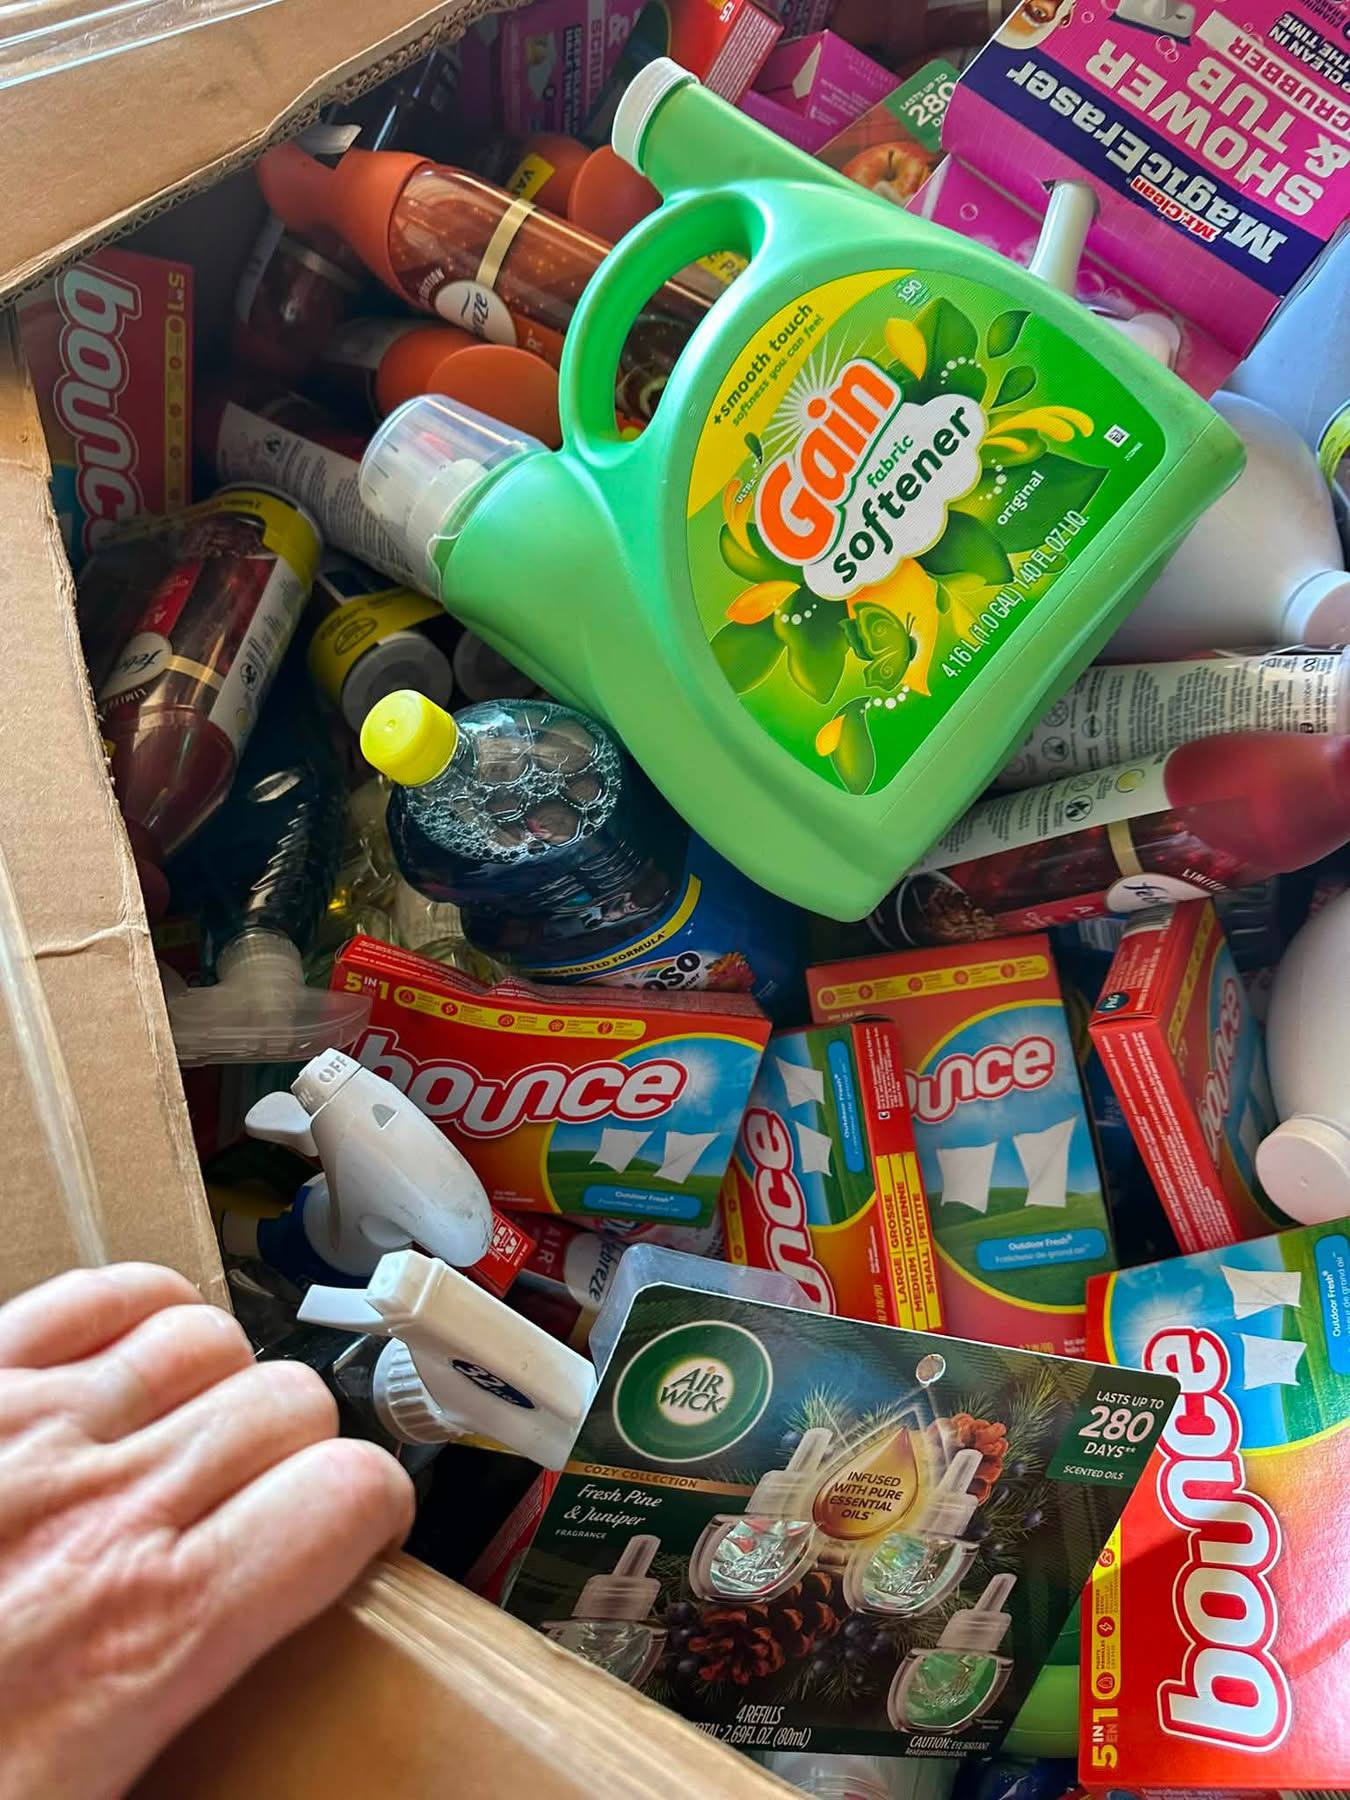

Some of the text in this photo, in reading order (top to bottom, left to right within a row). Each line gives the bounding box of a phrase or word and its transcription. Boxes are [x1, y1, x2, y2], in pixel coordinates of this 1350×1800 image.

[1279, 13, 1319, 49] TIME
[1269, 26, 1344, 84] CLEAN IN
[901, 73, 948, 110] LASTS UP TO
[907, 81, 956, 127] 280
[1187, 57, 1296, 153] TUB
[1228, 36, 1350, 131] CRUBBER
[1085, 39, 1324, 217] SHOWER
[1304, 133, 1350, 179] &
[768, 305, 813, 351] touch
[733, 314, 824, 426] softness you can feel
[54, 267, 142, 548] bounc
[758, 362, 896, 560] Gain
[866, 435, 914, 490] fabric
[735, 476, 757, 503] ULTRA
[833, 407, 971, 583] softener
[996, 470, 1044, 525] original
[941, 645, 973, 678] 4.16
[989, 586, 1026, 619] GAL)
[1013, 562, 1043, 589] 140
[1030, 551, 1057, 569] FL
[1044, 528, 1070, 553] OZ
[1058, 510, 1090, 536] LIQ.
[344, 972, 363, 993] 5
[364, 976, 377, 987] IN
[379, 981, 390, 1000] 1
[353, 1030, 686, 1136] bounce
[904, 1037, 1056, 1122] unce
[745, 1110, 835, 1313] unce
[884, 1194, 907, 1304] LARGE GROSSE
[896, 1181, 923, 1312] MEDIUM MOYENNE
[913, 1193, 935, 1294] SMALL PETITE
[1326, 1273, 1341, 1337] Outdoor Fresh
[1339, 1269, 1350, 1295] grand
[659, 1386, 727, 1413] WICK
[669, 1366, 724, 1395] AIR
[1096, 1391, 1165, 1410] LASTS UP TO
[1078, 1405, 1155, 1443] 280
[577, 1483, 663, 1507] Fresh Pine
[584, 1465, 698, 1488] COZY COLLECTION
[832, 1482, 904, 1500] WITH PURE
[847, 1471, 901, 1487] INFUSED
[1063, 1465, 1125, 1480] SCENTED OILS
[563, 1505, 647, 1528] & Juniper
[829, 1495, 892, 1512] ESSENTIAL
[554, 1528, 608, 1540] FRAGRANCE
[1148, 1329, 1288, 1745] bounce
[736, 1704, 785, 1725] 4 REFILLS
[910, 1735, 952, 1749] CAUTION:
[1092, 1708, 1119, 1769] 5 IN EN 1
